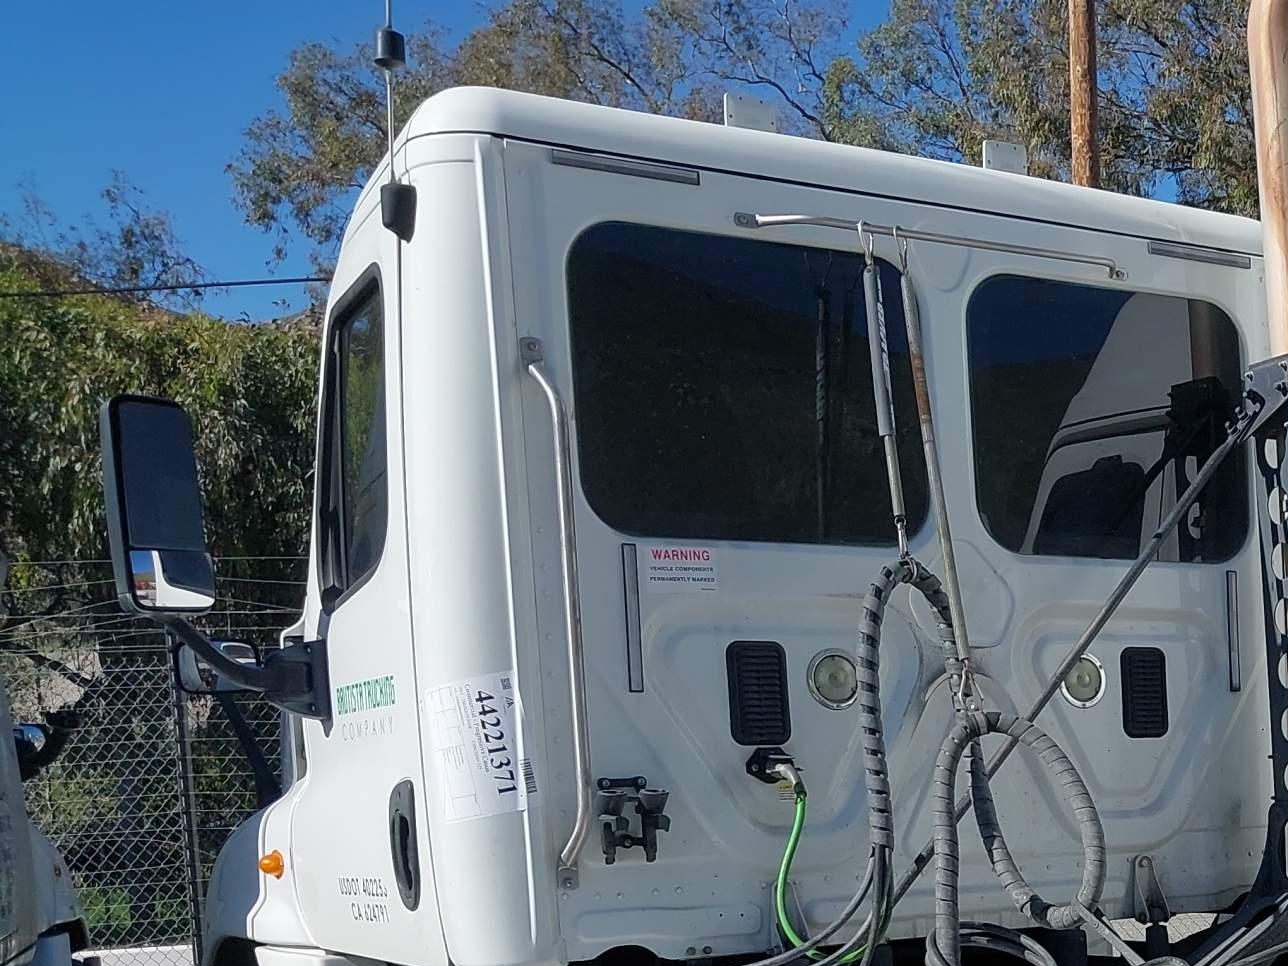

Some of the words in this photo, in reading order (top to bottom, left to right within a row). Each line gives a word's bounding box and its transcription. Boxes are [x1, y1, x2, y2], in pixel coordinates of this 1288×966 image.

[651, 548, 711, 561] WARNING
[363, 675, 396, 710] TRUCKING
[342, 716, 393, 741] COMPANY
[475, 690, 518, 796] 44221371
[338, 877, 361, 896] USDOT
[351, 902, 364, 921] CA
[364, 903, 390, 924] 624791
